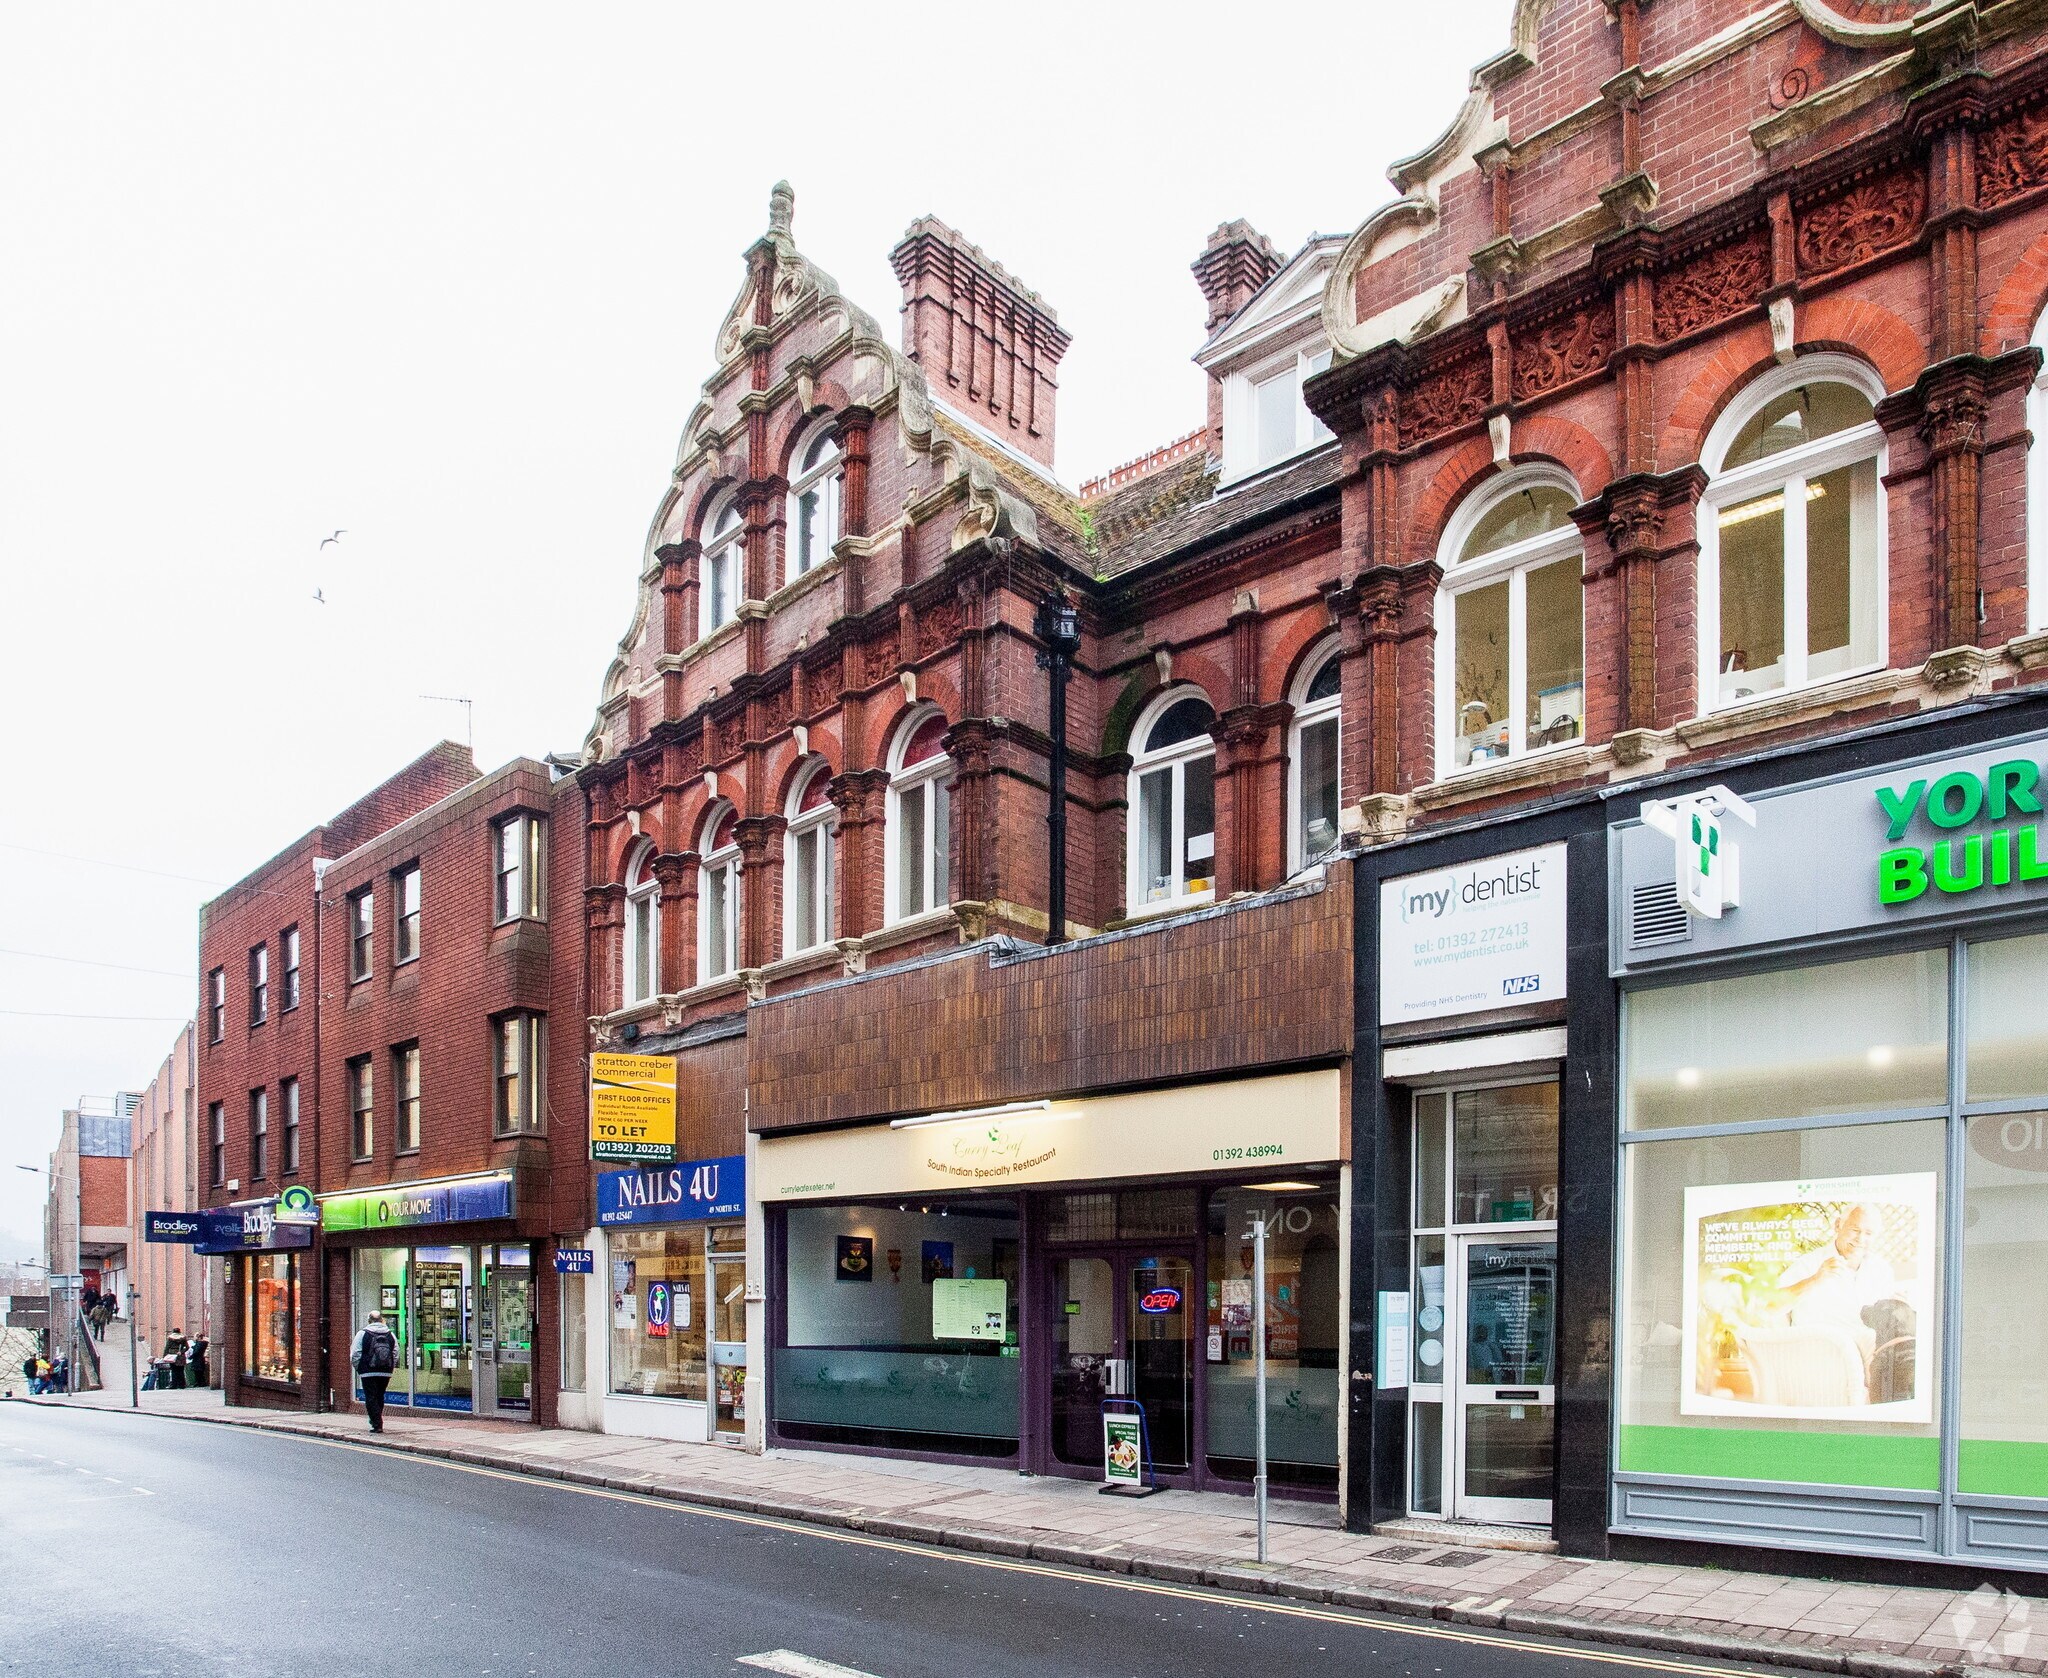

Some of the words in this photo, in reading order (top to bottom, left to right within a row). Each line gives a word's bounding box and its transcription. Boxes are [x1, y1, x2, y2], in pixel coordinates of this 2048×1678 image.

[1878, 824, 2048, 904] BUIL
[1414, 941, 1434, 955] tel:
[1437, 931, 1476, 951] 01392
[1481, 921, 1529, 943] 272413
[1413, 938, 1530, 968] www.mydentist.co.uk
[1504, 976, 1539, 995] NHS
[1404, 998, 1437, 1011] Providing
[1438, 995, 1454, 1005] NHS
[1455, 990, 1488, 1003] Dentistry
[597, 1058, 637, 1067] stratton
[640, 1060, 672, 1069] creber
[597, 1068, 656, 1078] commercial
[619, 1095, 640, 1103] FLOOR
[643, 1096, 671, 1104] OFFICES
[598, 1125, 617, 1136] TO
[622, 1126, 647, 1137] LET
[596, 1142, 633, 1153] (01392)
[635, 1144, 672, 1154] 202203
[1212, 1147, 1243, 1161] 01392
[1246, 1144, 1283, 1158] 438994
[927, 1158, 947, 1173] South
[949, 1165, 973, 1177] Indian
[974, 1165, 1011, 1179] Specialty
[1012, 1147, 1057, 1173] Restaurant
[618, 1169, 683, 1208] NAILS
[689, 1164, 720, 1201] 4U
[780, 1182, 836, 1194] curryleafexeter.net
[389, 1202, 410, 1217] YOUR
[410, 1198, 432, 1215] MOVE
[715, 1205, 732, 1213] NORTH
[153, 1220, 198, 1235] Bradleys
[1705, 1222, 1739, 1233] WE'VE
[1742, 1220, 1791, 1232] ALWAYS
[1705, 1231, 1772, 1243] COMMITTED
[1776, 1230, 1791, 1241] TO
[1768, 1240, 1794, 1251] AND
[557, 1251, 591, 1261] NAILS
[1705, 1252, 1752, 1263] ALWAYS
[1753, 1251, 1780, 1262] WILL
[566, 1261, 581, 1272] 4U
[1143, 1294, 1178, 1308] OPEN
[648, 1323, 669, 1336] NAILS
